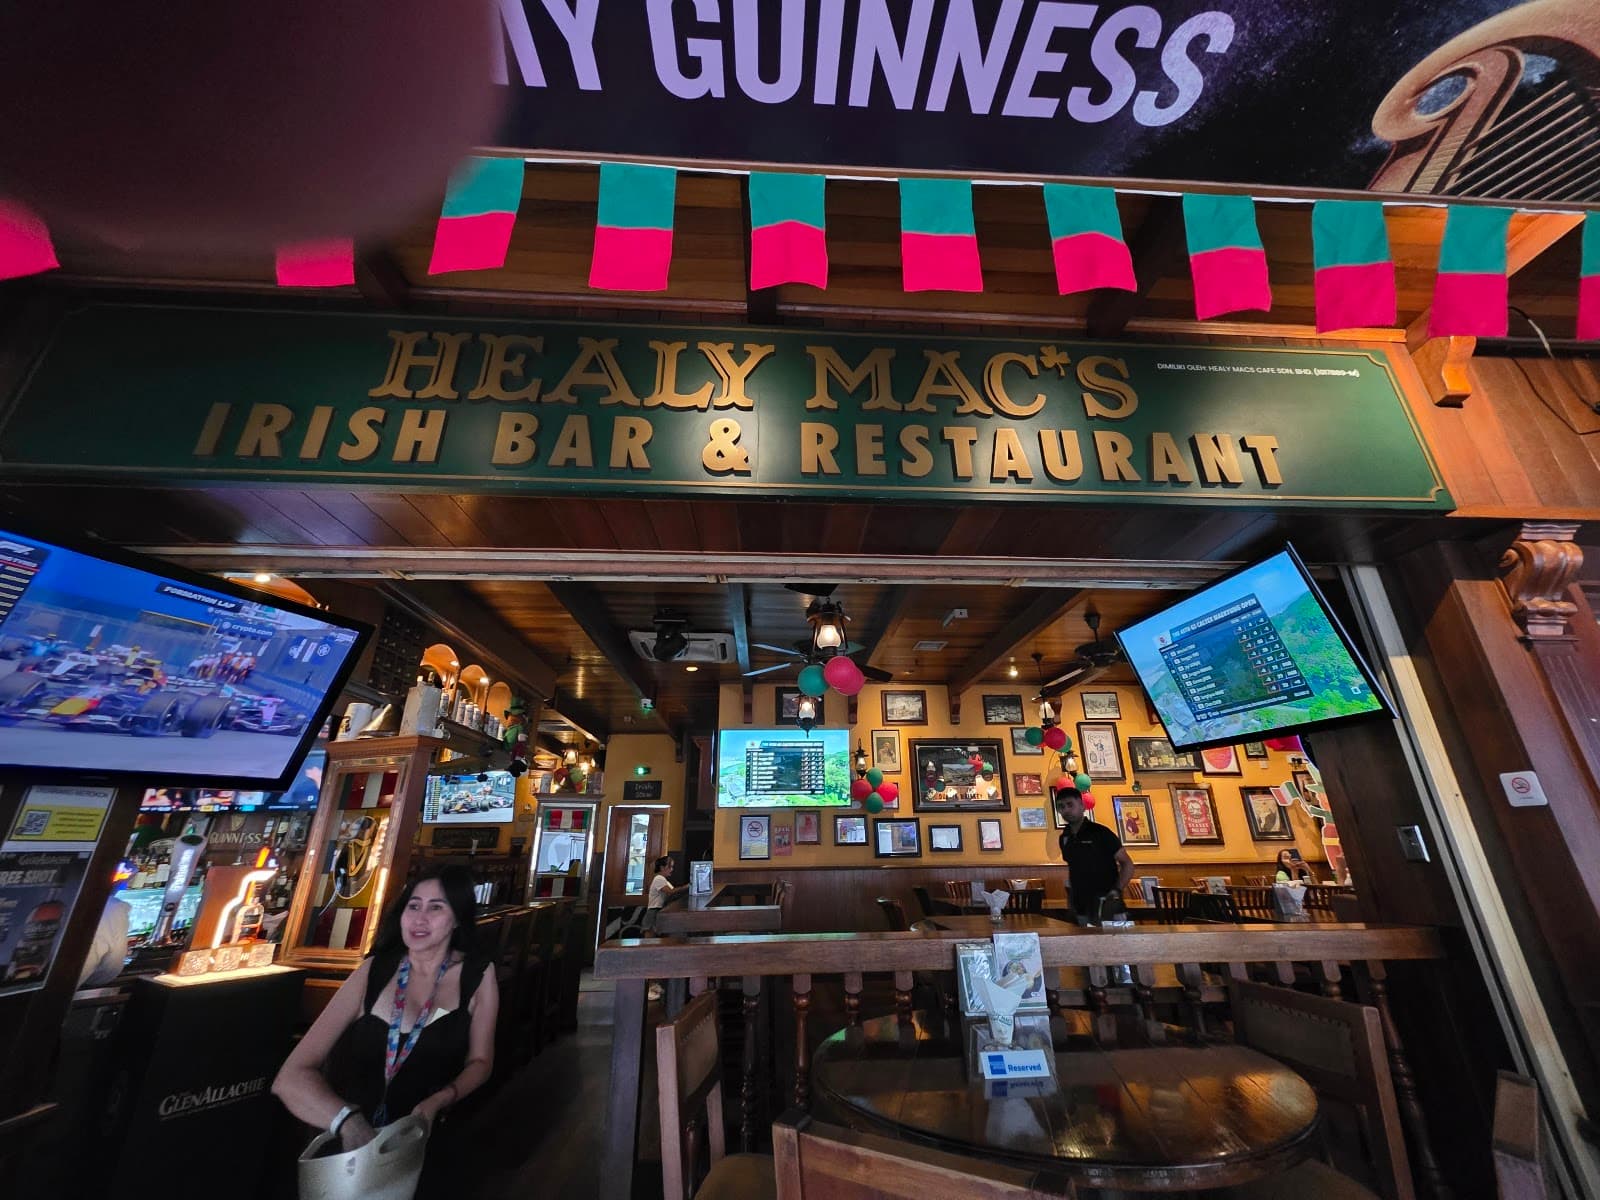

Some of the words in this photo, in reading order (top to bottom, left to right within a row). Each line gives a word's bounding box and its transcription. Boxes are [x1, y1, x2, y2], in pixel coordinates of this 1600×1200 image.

[645, 0, 1235, 127] GUINNESS
[369, 329, 776, 411] HEALY
[1256, 366, 1275, 374] CAFE
[194, 401, 448, 464] IRISH
[492, 411, 655, 471] BAR
[702, 417, 752, 475] &
[800, 421, 1284, 487] RESTAURANT
[163, 586, 217, 605] FORMATION
[217, 599, 236, 609] LAP
[231, 624, 273, 636] crypto.com
[0, 870, 24, 885] REE
[24, 869, 58, 883] SHOT
[1008, 1064, 1041, 1072] Reserved
